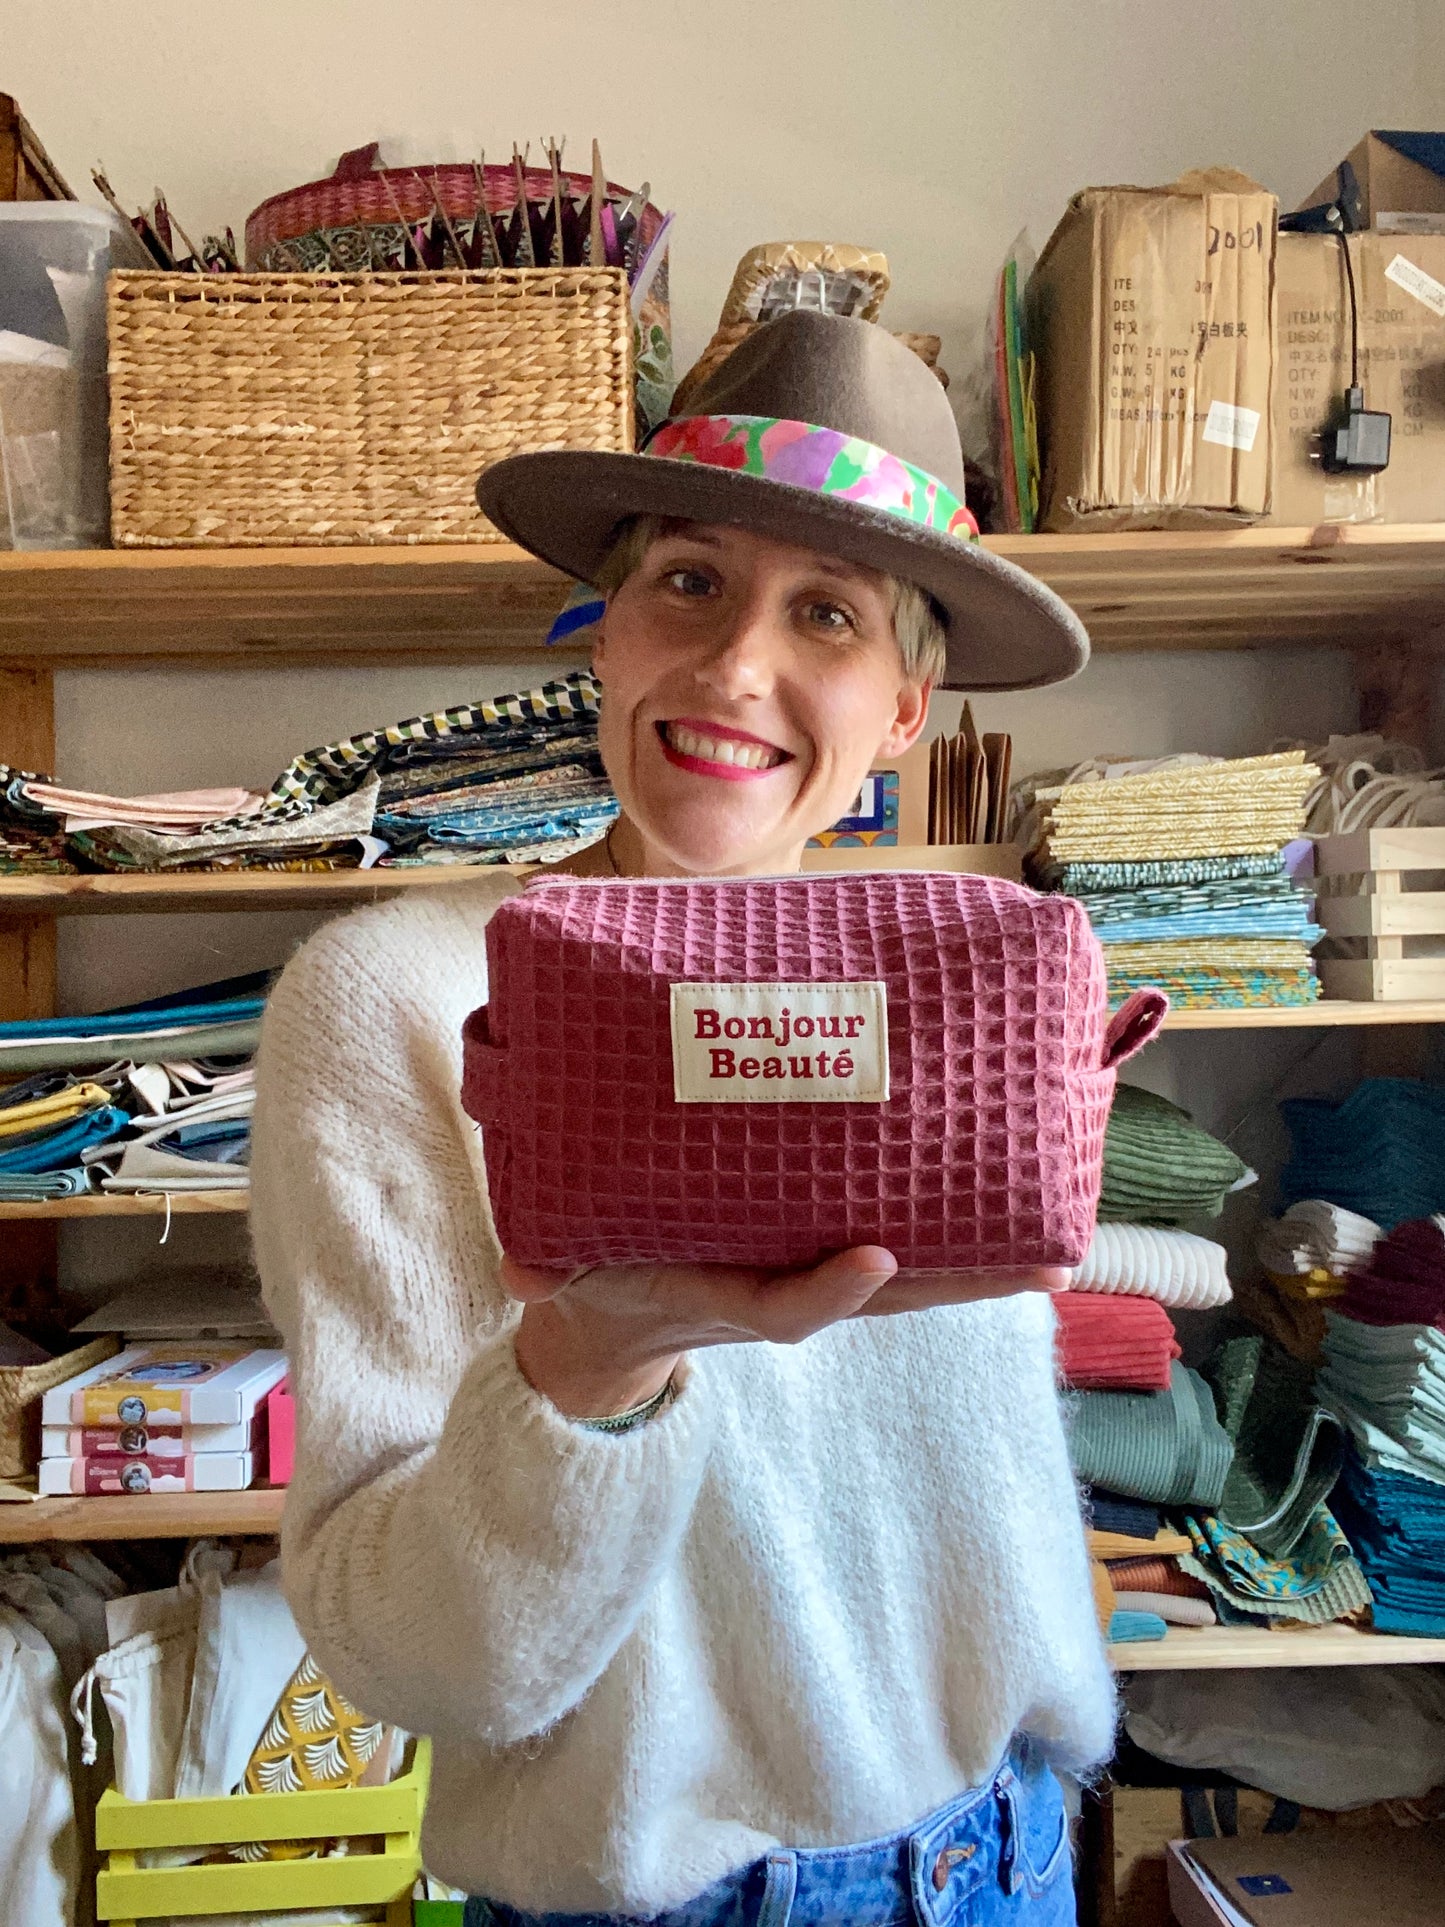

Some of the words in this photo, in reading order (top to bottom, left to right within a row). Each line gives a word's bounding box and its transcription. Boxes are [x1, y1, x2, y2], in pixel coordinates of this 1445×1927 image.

[1207, 221, 1263, 256] 2001
[1145, 363, 1152, 376] 5
[1170, 365, 1186, 378] KG
[694, 1008, 865, 1047] Bonjour
[708, 1048, 855, 1079] Beauté
